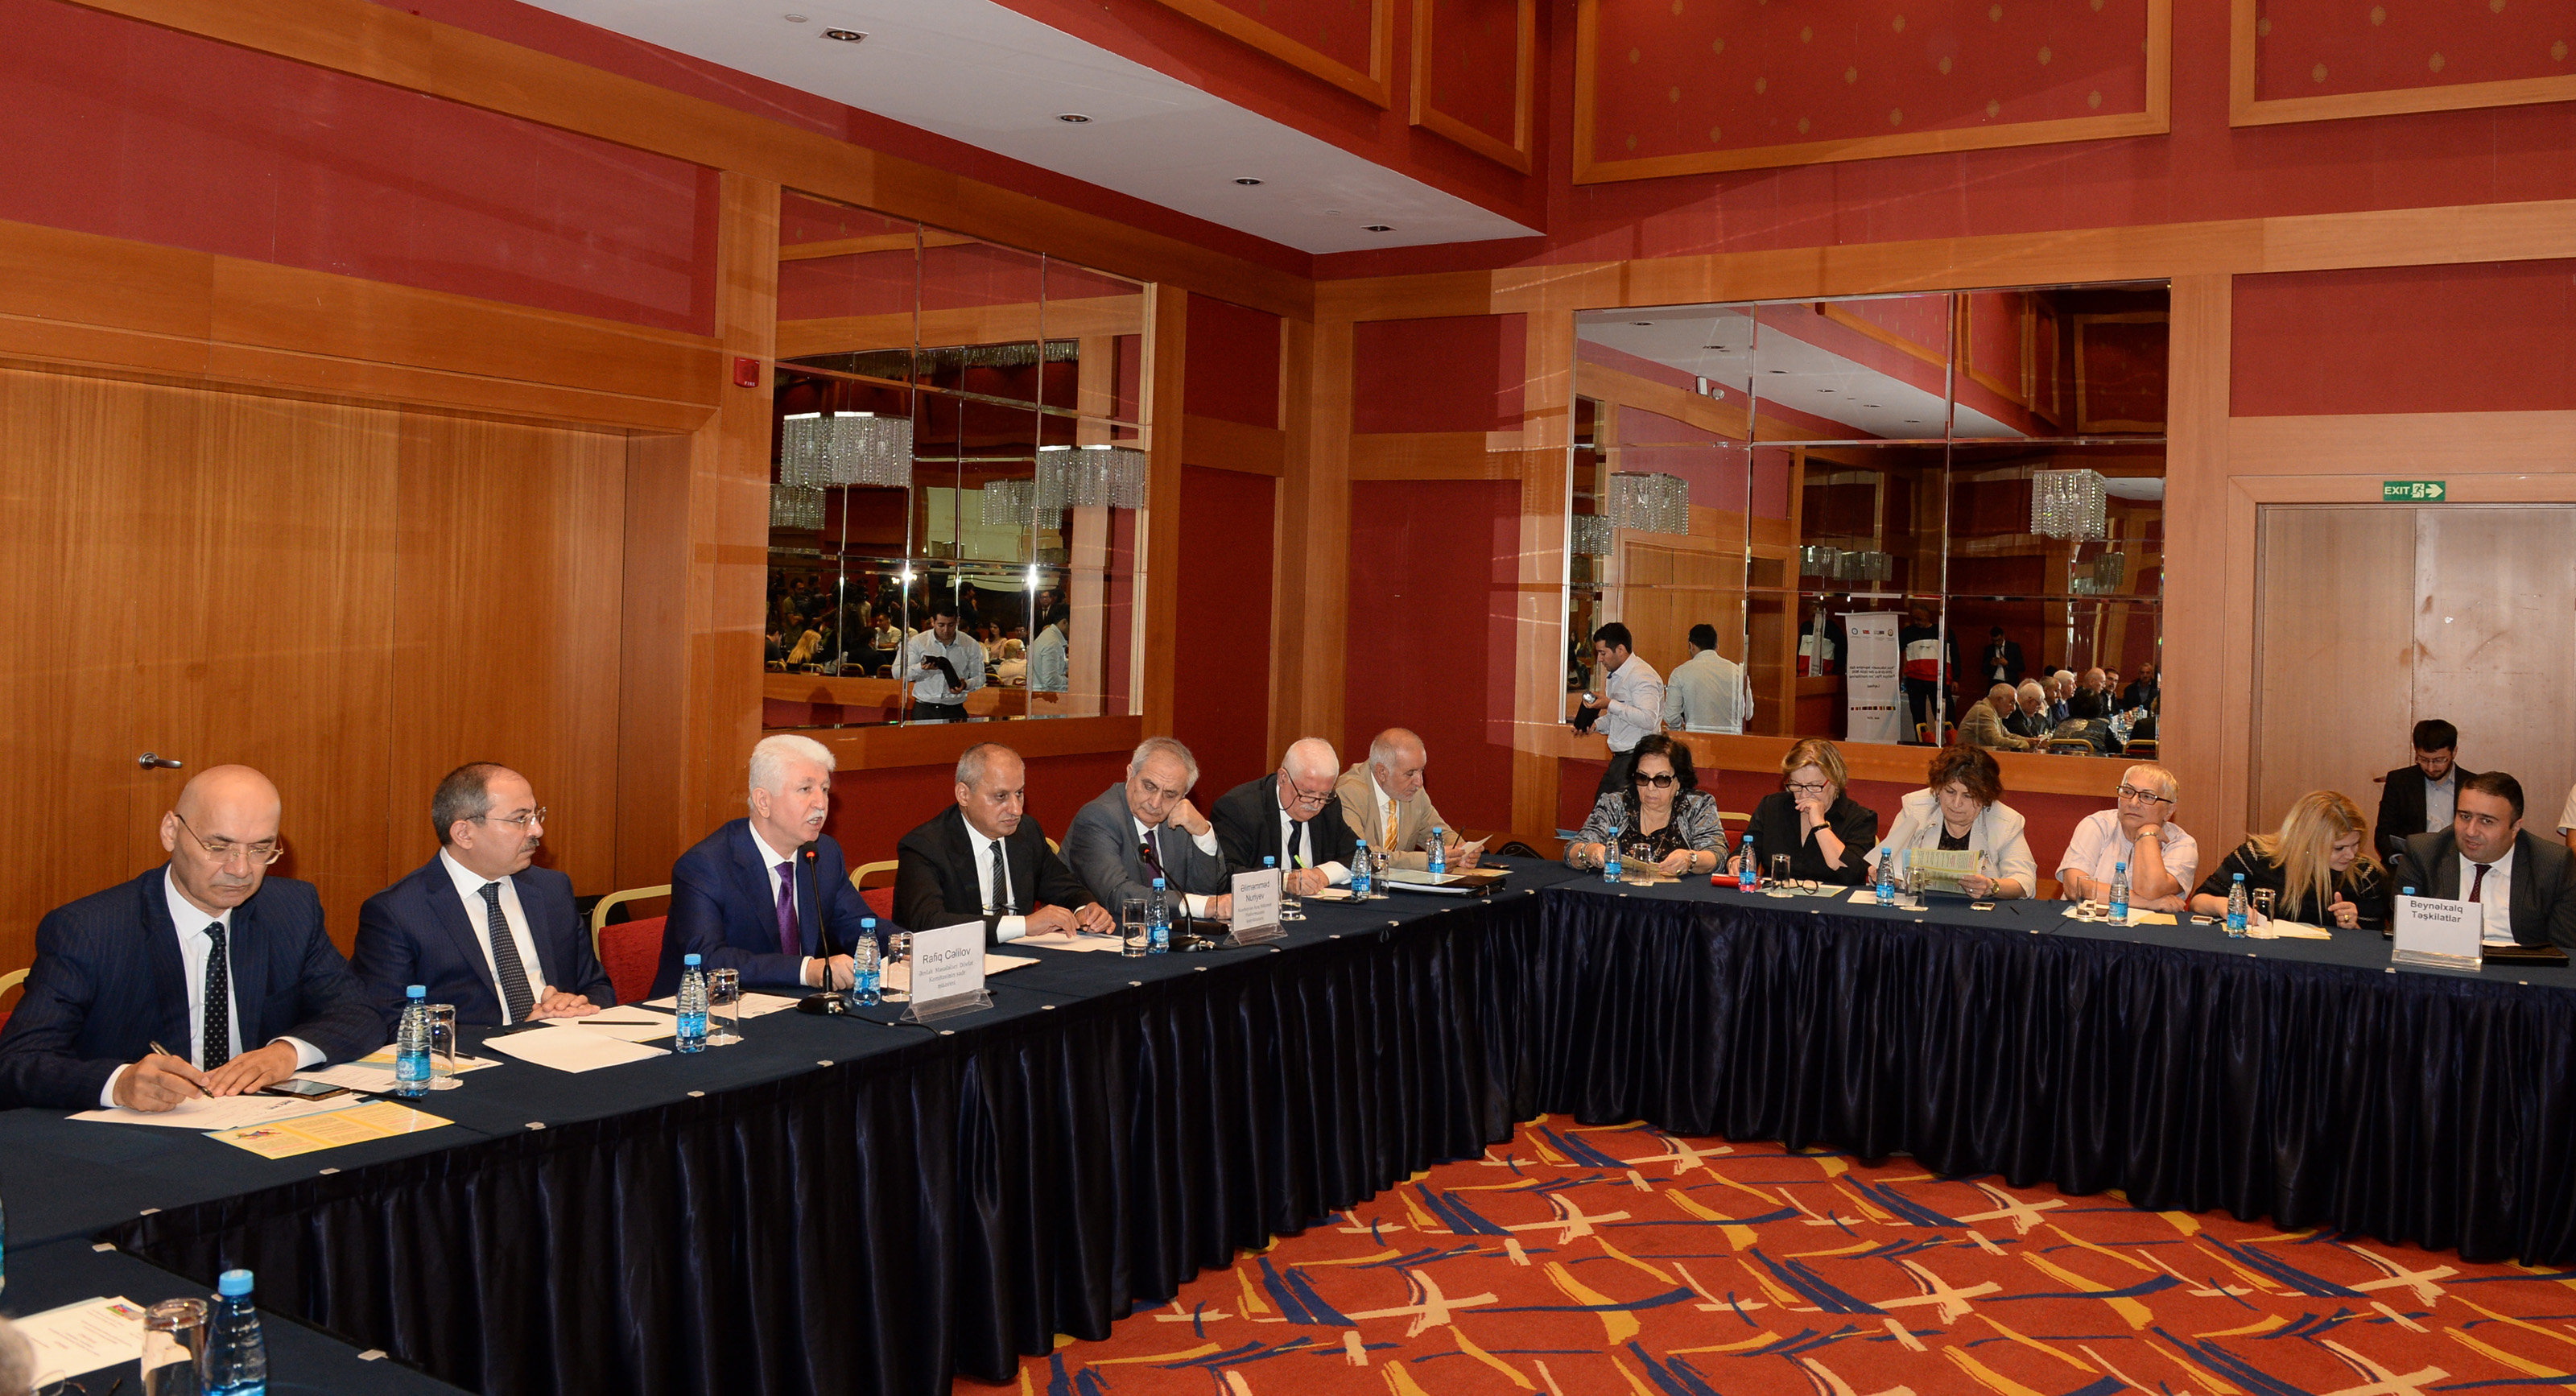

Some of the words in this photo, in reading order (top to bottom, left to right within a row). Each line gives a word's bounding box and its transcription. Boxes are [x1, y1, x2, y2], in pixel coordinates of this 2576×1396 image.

[2384, 486, 2410, 495] EXIT
[1245, 893, 1265, 902] Nuriyev
[2410, 900, 2463, 914] Beynəlxalq
[2412, 911, 2462, 923] Təşkilatlar
[923, 952, 943, 964] Rafiq
[944, 948, 972, 960] Cəlilov
